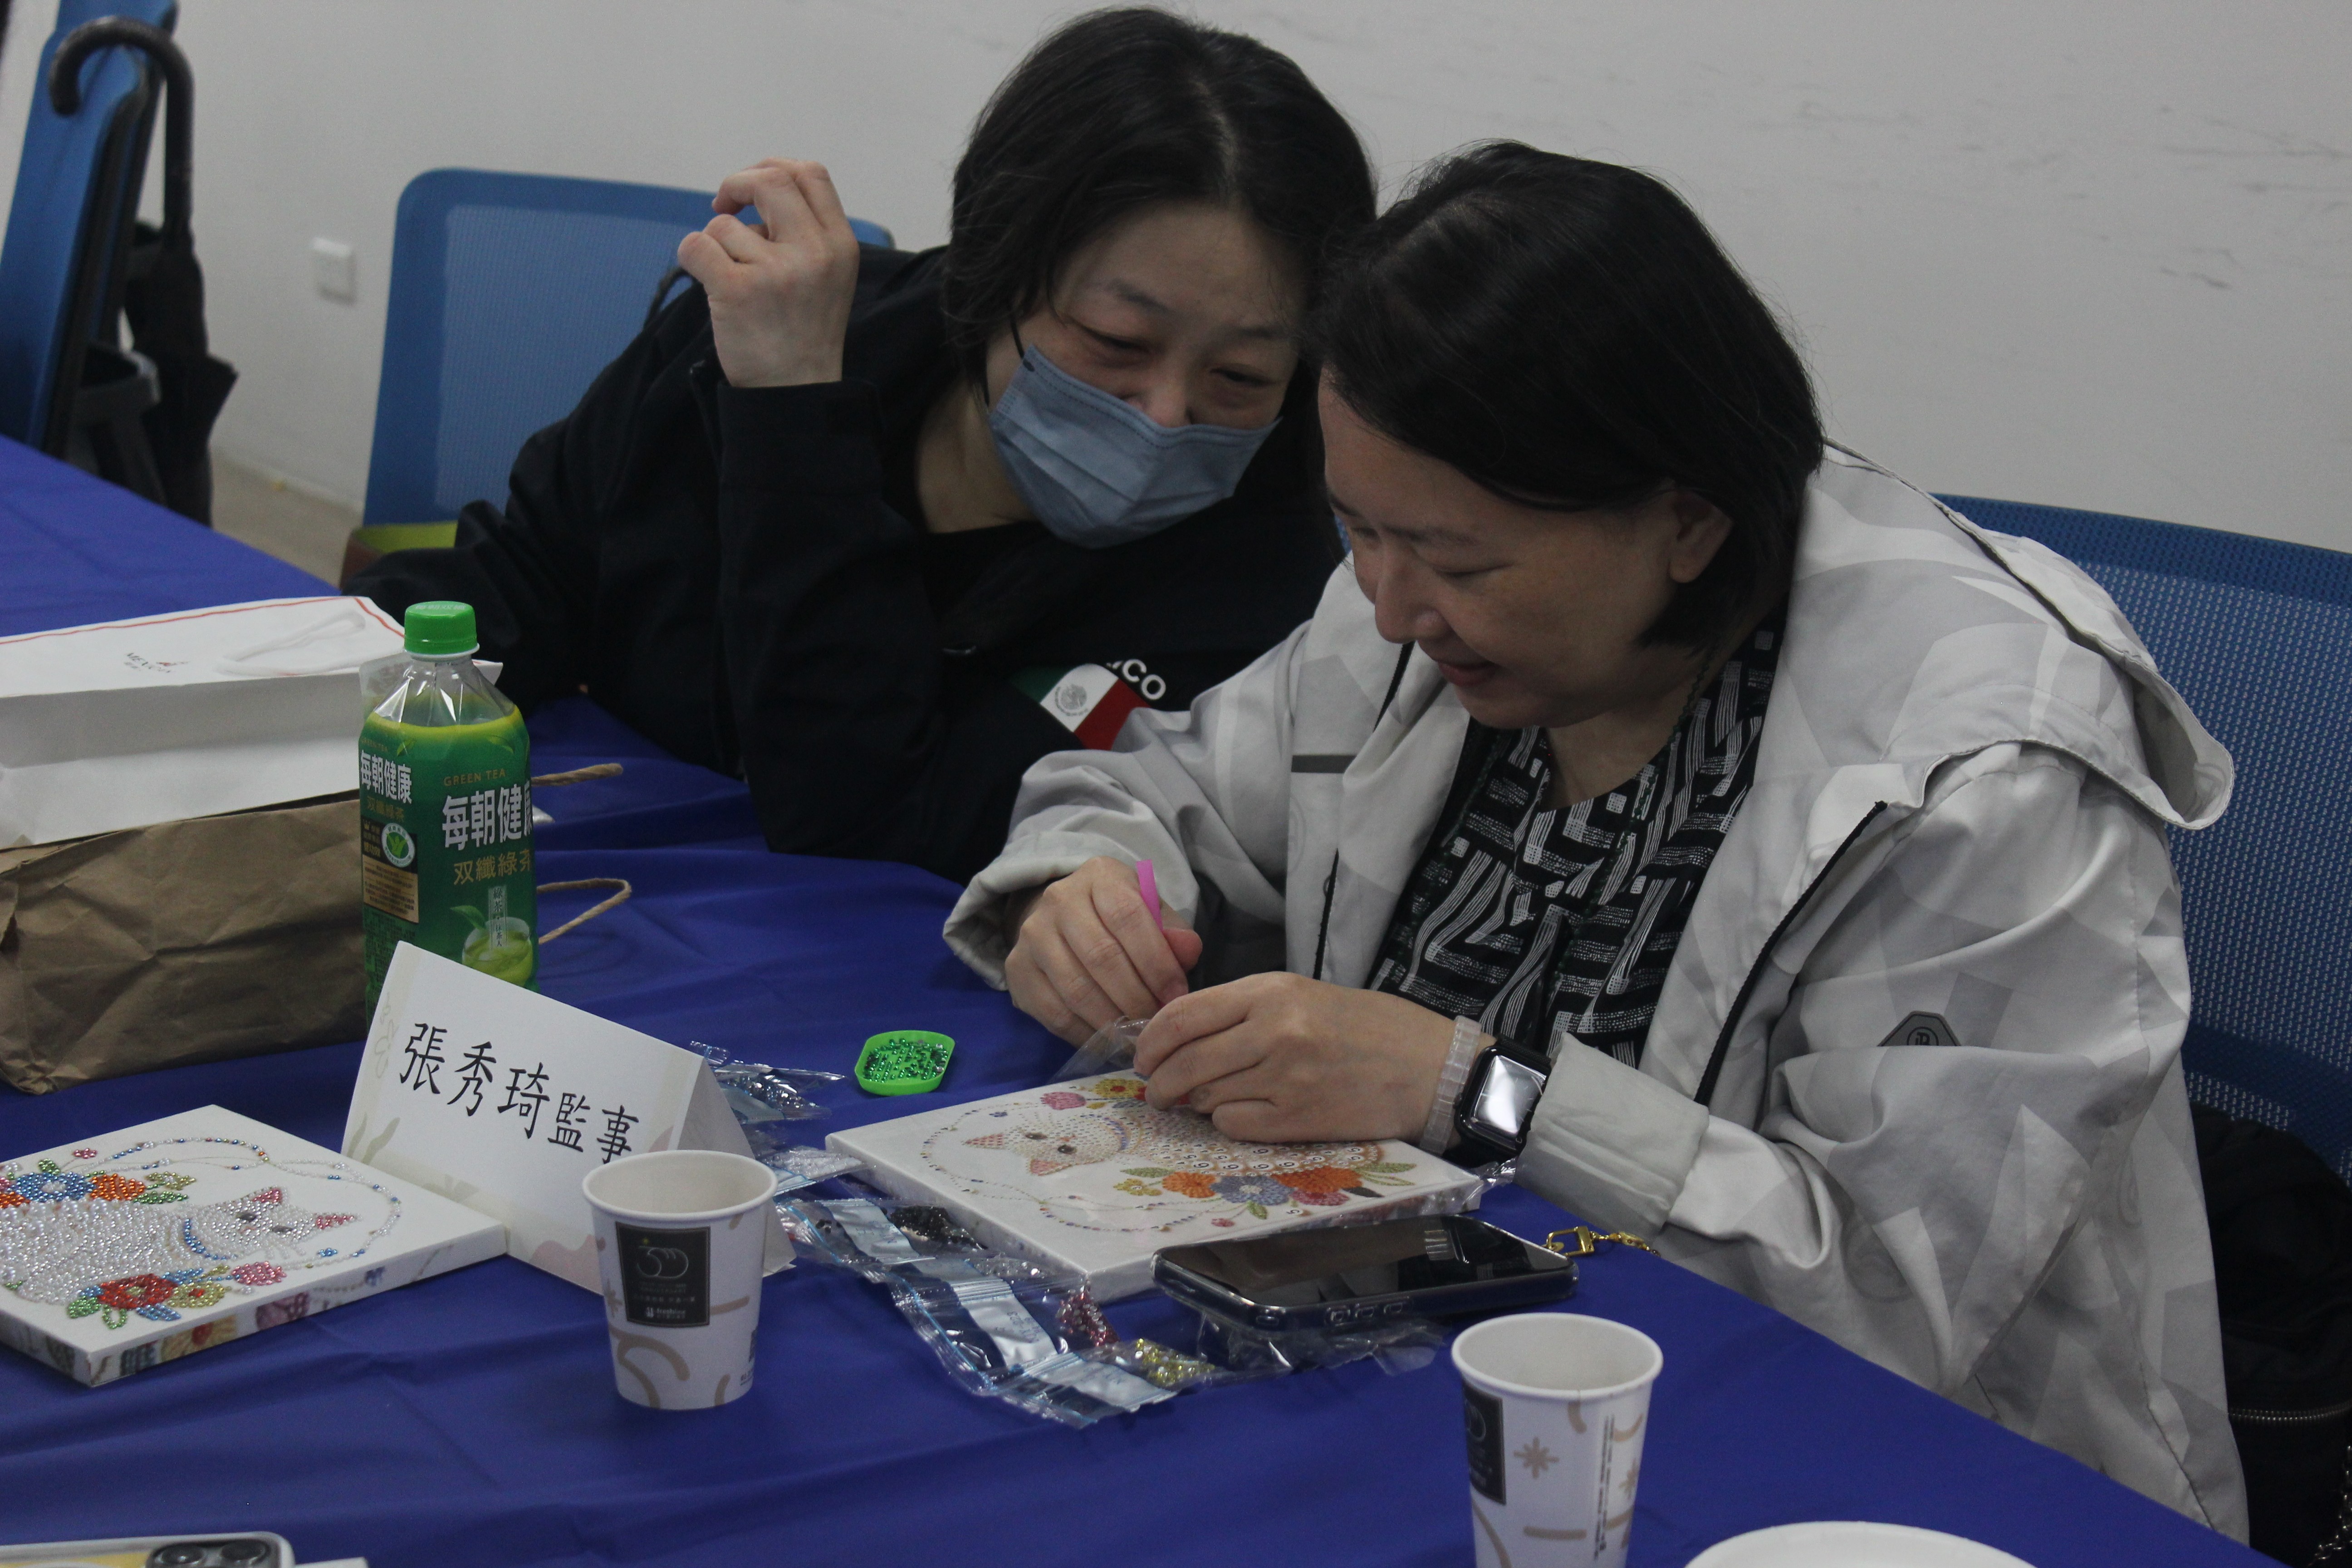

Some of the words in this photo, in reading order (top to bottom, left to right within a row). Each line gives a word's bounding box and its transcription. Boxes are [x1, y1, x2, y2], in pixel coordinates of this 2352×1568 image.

[361, 749, 412, 804] 每朝健康
[444, 773, 481, 786] GREEN
[486, 768, 506, 780] TEA
[400, 1023, 639, 1165] 張秀琦監事
